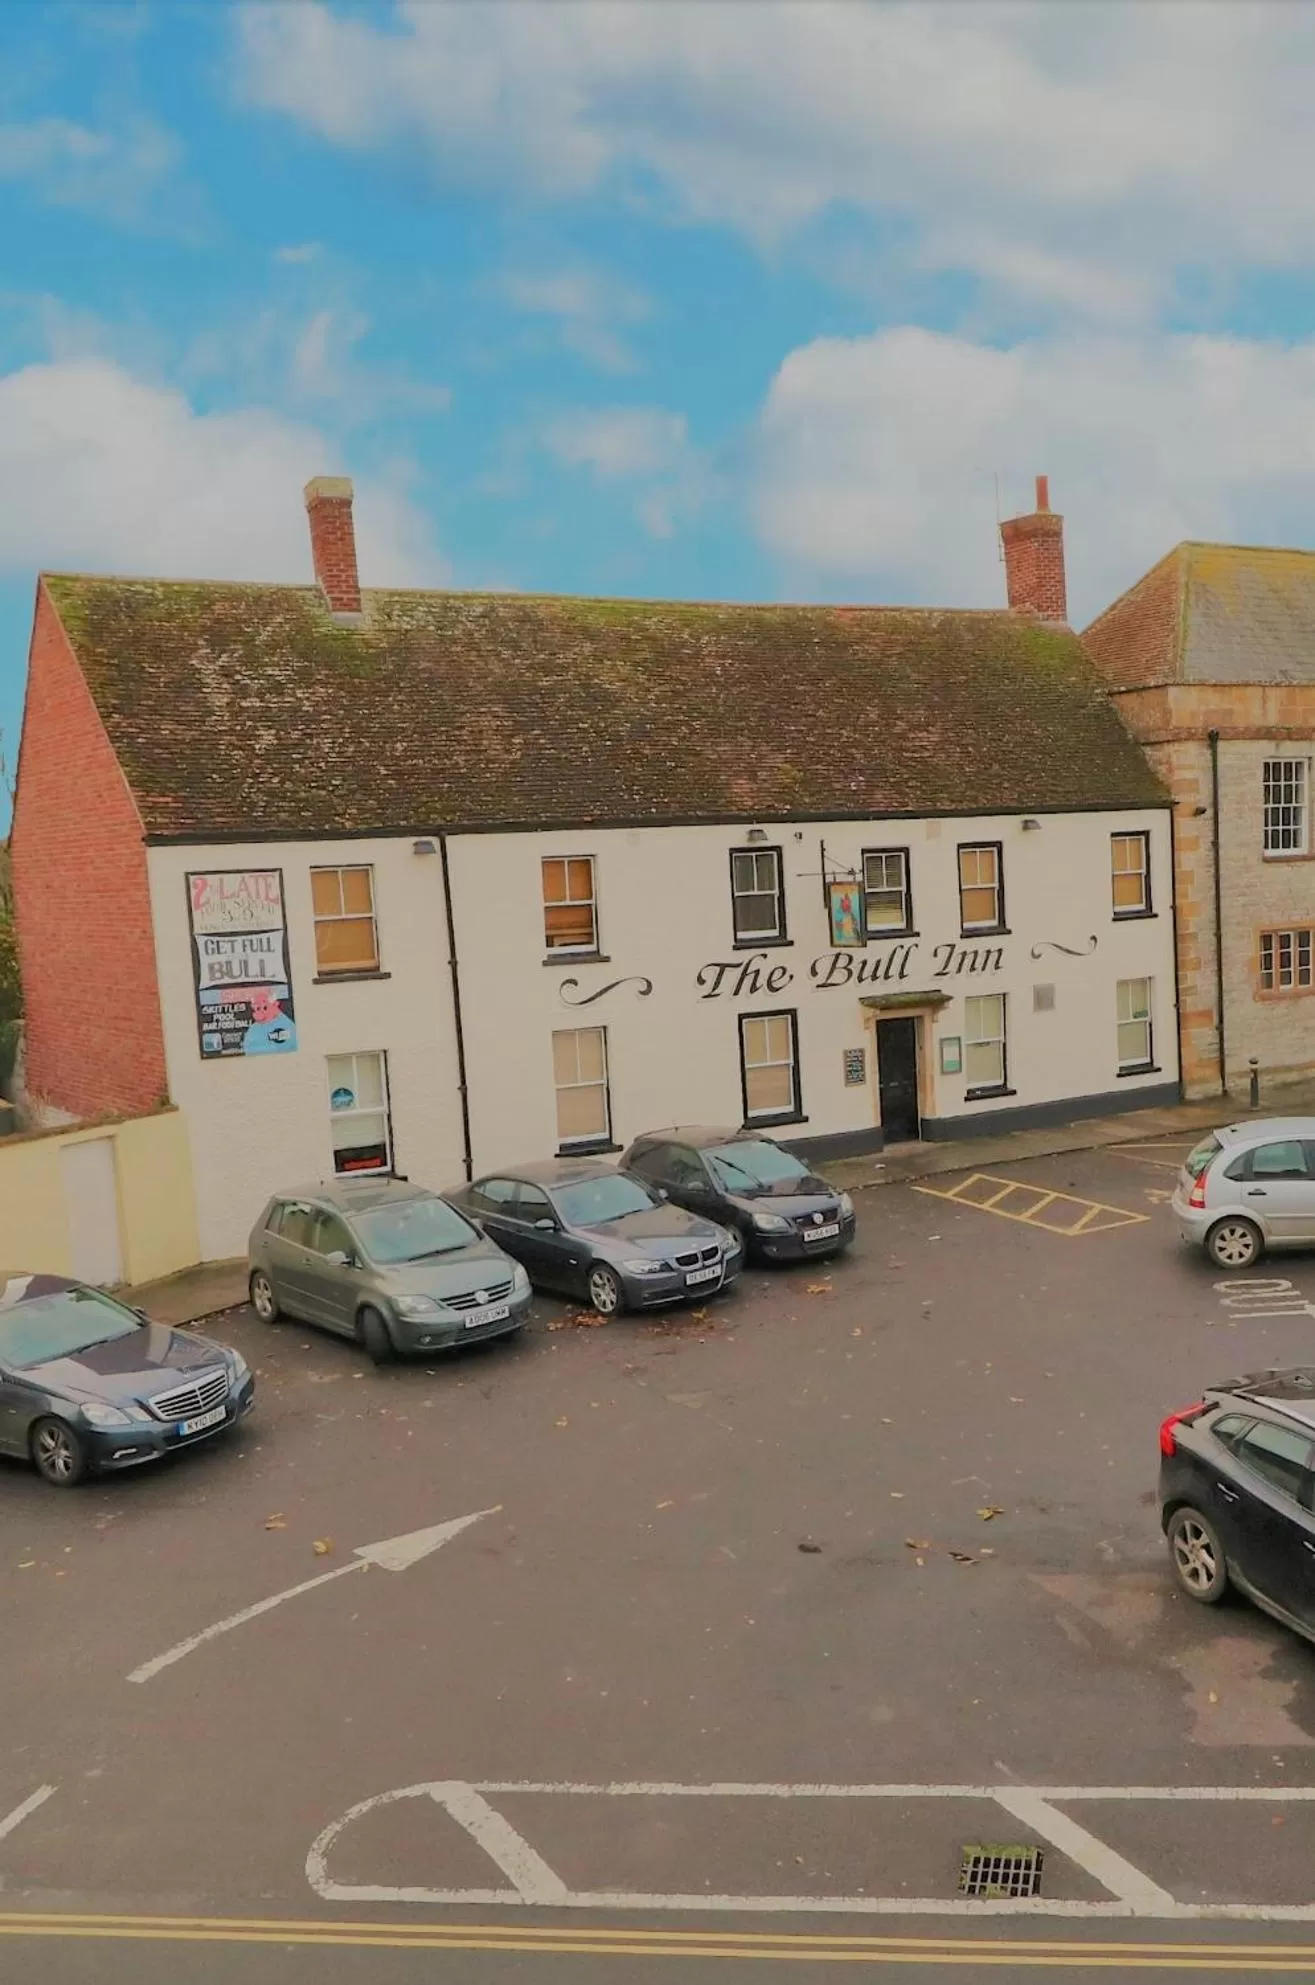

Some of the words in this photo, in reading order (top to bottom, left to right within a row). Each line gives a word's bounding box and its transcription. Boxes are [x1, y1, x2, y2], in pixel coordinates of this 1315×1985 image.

[218, 873, 280, 906] LATE
[204, 939, 239, 957] GET
[241, 936, 276, 953] FULL
[208, 959, 277, 981] BULL
[696, 952, 795, 1000] The
[810, 944, 919, 988] Bull
[932, 944, 1004, 977] Inn
[202, 1003, 246, 1015] SKITTLES
[212, 1012, 236, 1022] POOL
